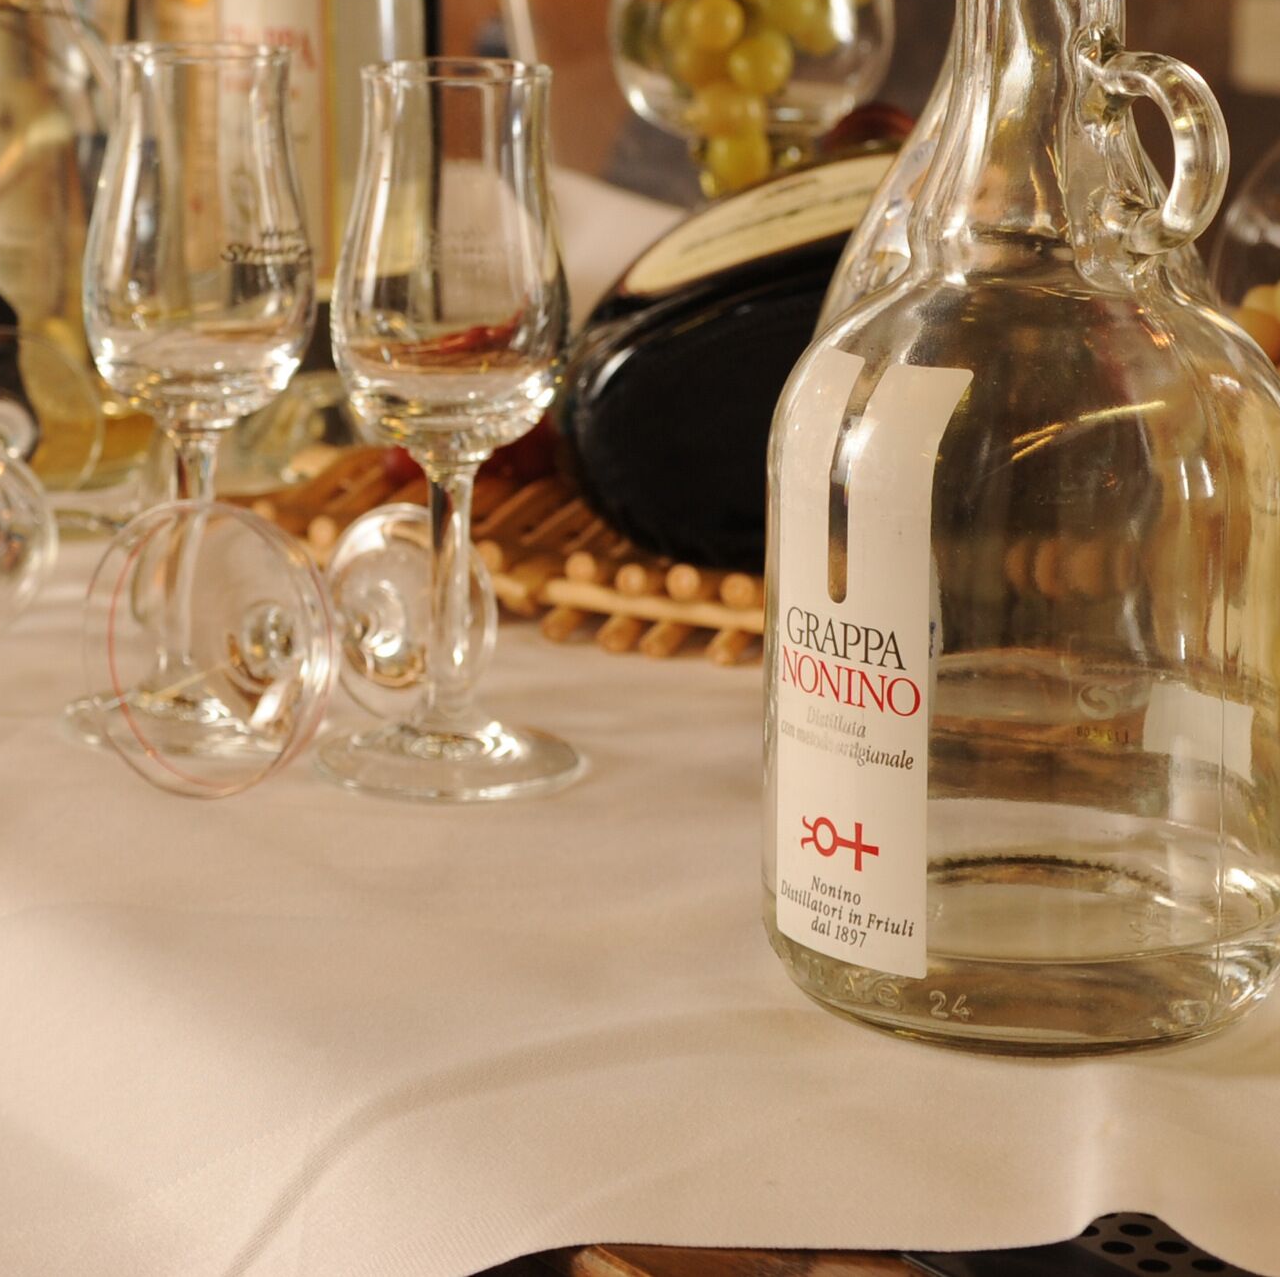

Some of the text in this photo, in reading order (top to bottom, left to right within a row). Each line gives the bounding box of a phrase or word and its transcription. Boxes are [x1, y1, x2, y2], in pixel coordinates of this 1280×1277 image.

[787, 606, 907, 671] GRAPPA
[782, 645, 921, 717] NONINO
[780, 879, 915, 938] Distillatori in Friuli
[811, 875, 861, 906] Nonino
[811, 915, 867, 948] dal 1897
[928, 990, 971, 1022] 24
